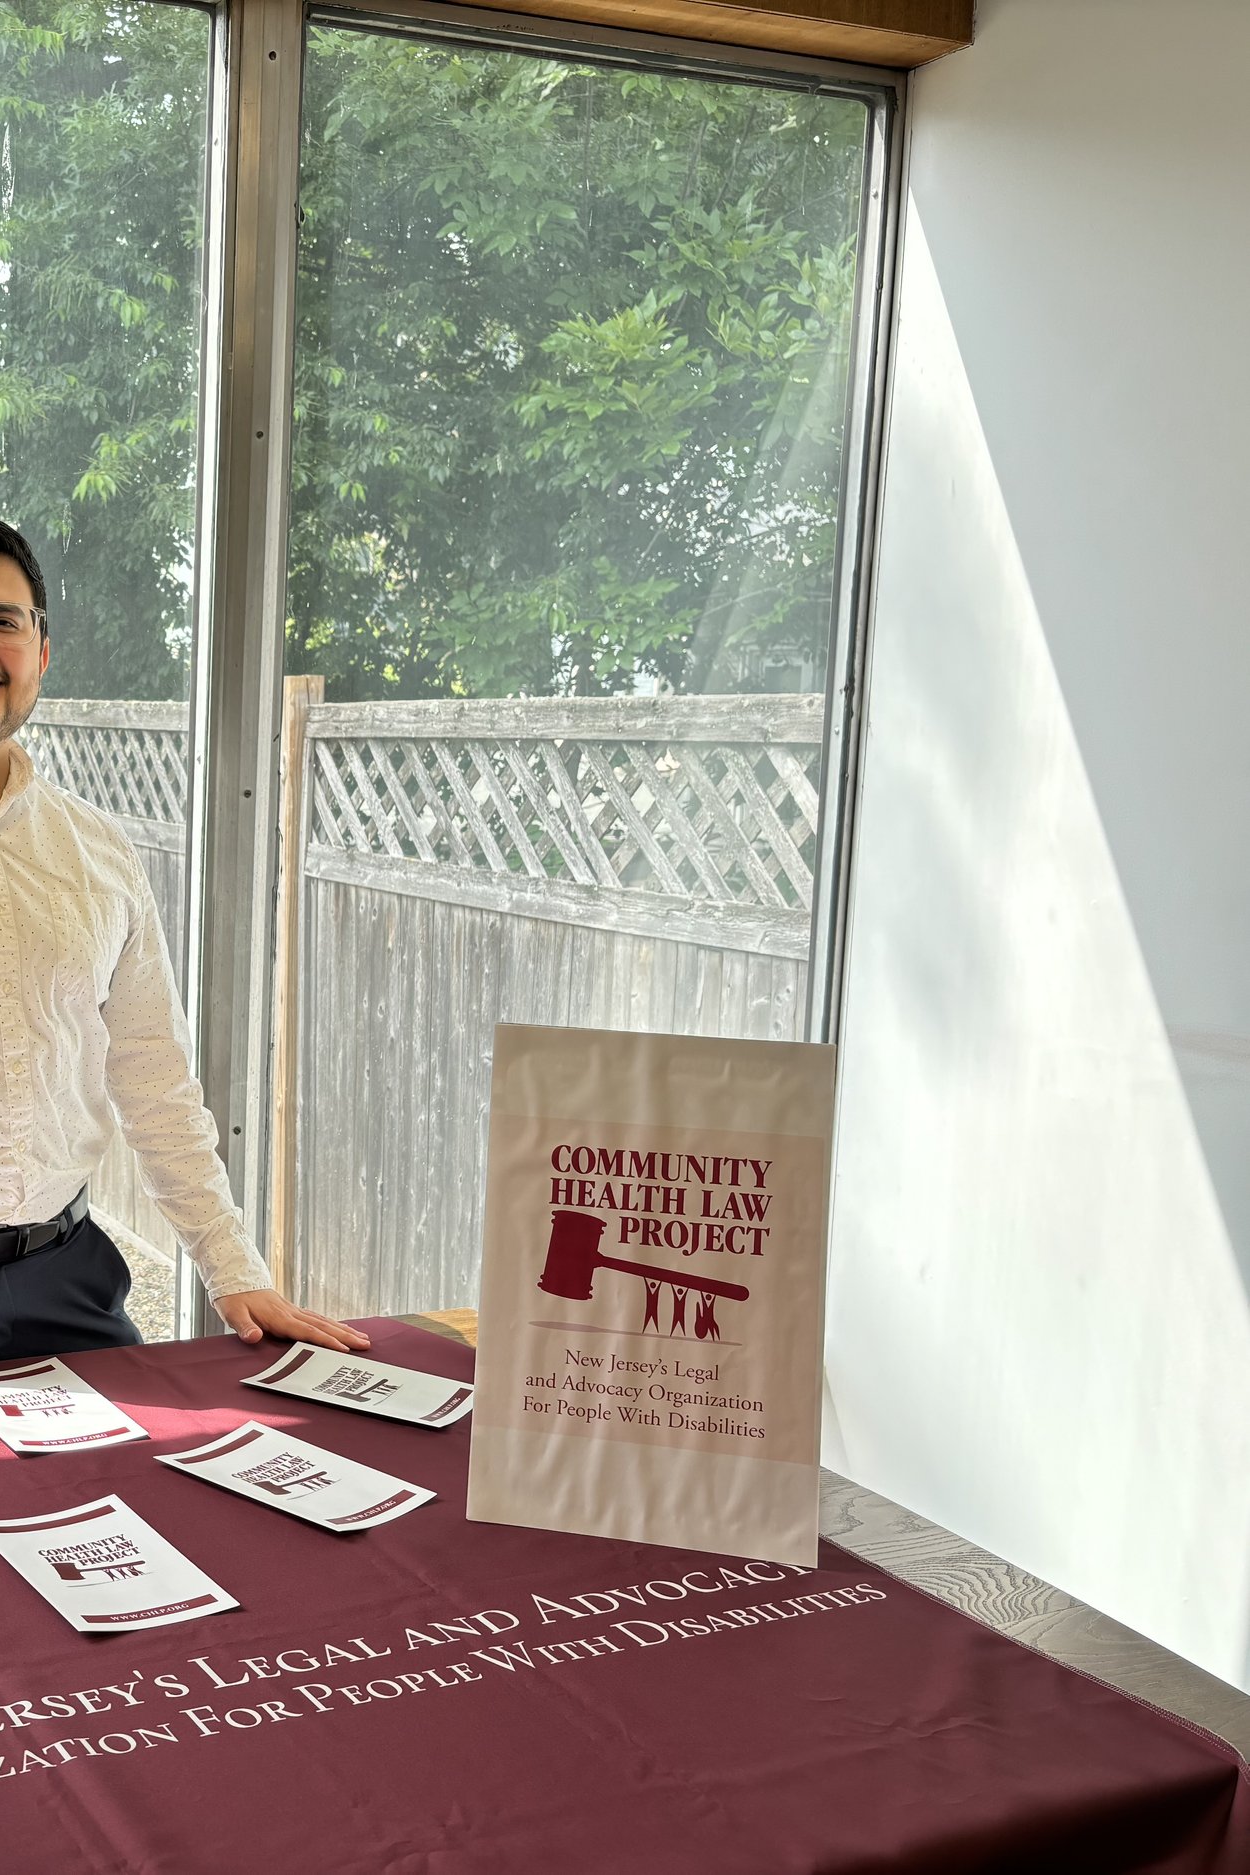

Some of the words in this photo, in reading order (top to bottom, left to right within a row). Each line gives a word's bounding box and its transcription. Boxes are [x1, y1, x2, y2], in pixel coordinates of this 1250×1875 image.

[550, 1144, 773, 1188] COMMUNITY
[549, 1177, 686, 1216] HEALTH
[700, 1187, 773, 1223] LAW
[617, 1215, 771, 1257] PROJECT
[565, 1349, 604, 1369] New
[608, 1352, 668, 1378] Jersey's
[674, 1361, 720, 1382] Legal
[347, 1370, 375, 1393] PROJECT
[525, 1371, 557, 1390] and
[561, 1375, 643, 1400] Advocacy
[649, 1384, 764, 1413] Organization
[523, 1396, 551, 1415] For
[557, 1398, 612, 1423] People
[617, 1405, 661, 1427] With
[668, 1411, 766, 1440] Disabilities
[231, 1451, 294, 1479] COMMUNITY
[244, 1464, 284, 1484] HEALTH
[281, 1456, 305, 1472] LAW
[271, 1460, 316, 1483] PROJECT
[38, 1533, 127, 1557] COMMUNITY
[44, 1548, 104, 1564] HEALTH
[105, 1540, 135, 1555] LAW
[78, 1547, 142, 1567] PROJECT
[109, 1602, 190, 1622] WWW.CHLP.ORG
[179, 1700, 303, 1738] FOR
[293, 1661, 484, 1716] PEOPLE
[474, 1634, 625, 1673] WITH
[610, 1582, 888, 1647] DISABILITIES
[188, 1636, 391, 1690] LEGAL
[404, 1609, 521, 1651] AND
